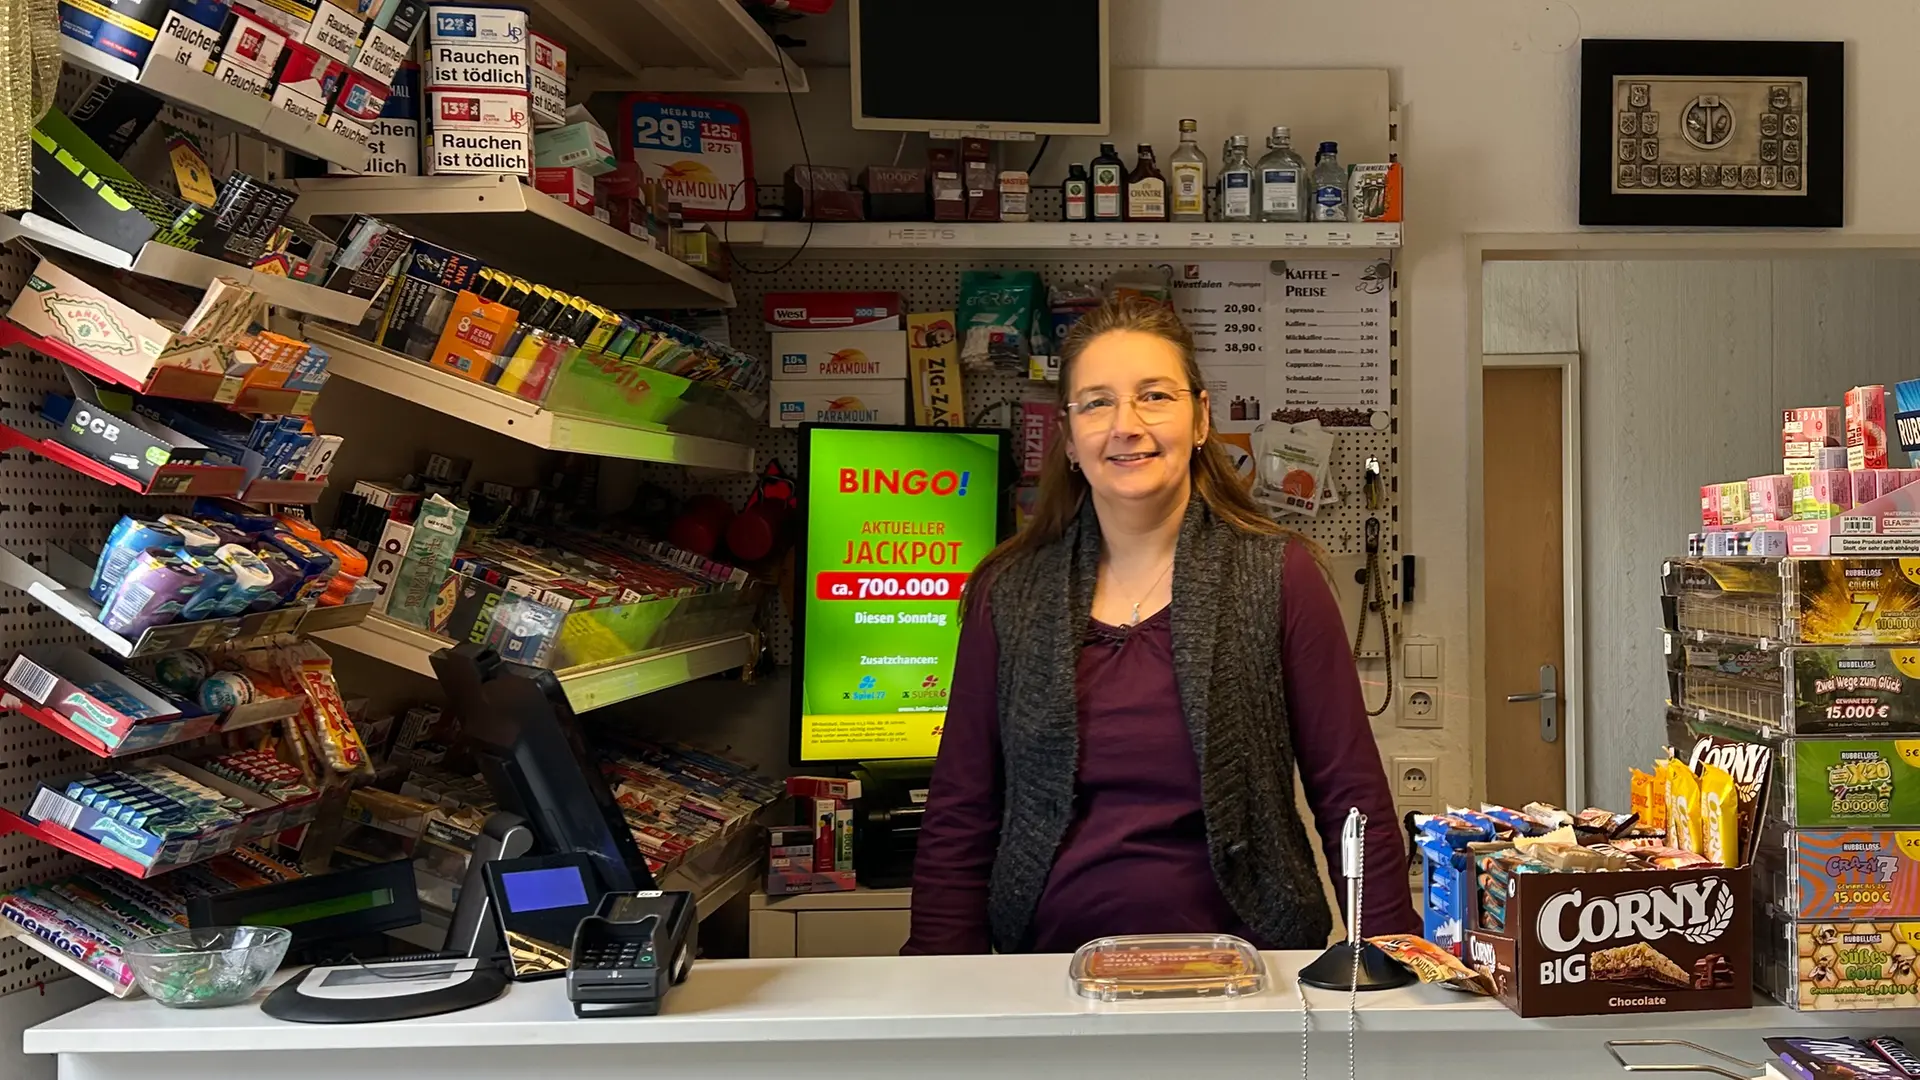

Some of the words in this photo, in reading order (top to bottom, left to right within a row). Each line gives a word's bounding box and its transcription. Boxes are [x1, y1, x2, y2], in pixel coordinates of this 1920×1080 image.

[325, 14, 358, 38] Rauchen
[316, 27, 329, 42] ist
[174, 46, 192, 66] ist
[359, 50, 373, 67] ist
[440, 48, 519, 65] Rauchen
[436, 66, 458, 81] ist
[463, 67, 524, 84] tödlich
[534, 75, 566, 101] Rauche
[283, 97, 318, 122] Rauchen
[660, 107, 688, 118] MEGA
[691, 109, 711, 120] BOX
[370, 121, 415, 138] chen
[636, 116, 682, 147] 29
[366, 141, 385, 154] st
[442, 134, 521, 150] Rauchen
[438, 152, 460, 166] ist
[465, 153, 526, 169] tödlich
[876, 172, 919, 182] MOODS
[888, 228, 956, 240] HEETS
[441, 255, 460, 287] NELLE
[454, 265, 469, 285] VAN
[1285, 268, 1328, 280] KAFFEE
[1174, 280, 1222, 288] Westfalen
[1285, 286, 1327, 297] PREISE
[776, 308, 805, 319] West
[855, 308, 873, 317] 200
[1224, 304, 1255, 314] 20,90
[457, 316, 472, 333] 8
[1224, 324, 1255, 334] 29,90
[470, 334, 490, 347] FILTER
[473, 327, 493, 341] FEIN
[1225, 343, 1256, 354] 38,90
[819, 362, 880, 375] PARAMOUNT
[817, 410, 878, 422] PARAMOUNT
[1784, 410, 1824, 422] ELFBAR
[75, 410, 120, 442] OCB
[1897, 417, 1920, 446] RUB
[1025, 414, 1044, 473] GIZEH
[839, 468, 970, 496] BINGO!
[861, 521, 946, 535] AKTUELLER
[842, 540, 963, 566] JACKPOT
[831, 583, 853, 596] ca.
[857, 577, 950, 599] 700.000
[469, 592, 501, 644] GIZEH
[854, 612, 895, 624] Diesen
[897, 612, 947, 626] Sonntag
[1850, 593, 1880, 631] 7
[860, 655, 939, 665] Zusatzchancen:
[1838, 660, 1876, 668] RUBBELLOSE
[1815, 675, 1835, 693] Zwei
[1836, 675, 1859, 690] Wege
[1860, 677, 1878, 688] zum
[1878, 675, 1902, 691] Glück
[1826, 705, 1875, 719] 15.000
[1877, 705, 1890, 718] €
[1832, 799, 1877, 812] 50.000
[1877, 800, 1889, 812] €
[1826, 855, 1880, 878] CRAZY
[1877, 855, 1899, 882] 7
[1833, 891, 1880, 903] 15.000
[1881, 892, 1891, 902] €
[1537, 876, 1719, 953] CORNY
[1, 902, 87, 960] mentos
[1907, 932, 1912, 940] 1
[1839, 948, 1888, 965] Süßes
[1540, 953, 1587, 985] BIG
[1845, 964, 1882, 980] Gold
[1865, 984, 1907, 995] 3.000
[1907, 984, 1919, 995] €
[1608, 995, 1667, 1007] Chocolate
